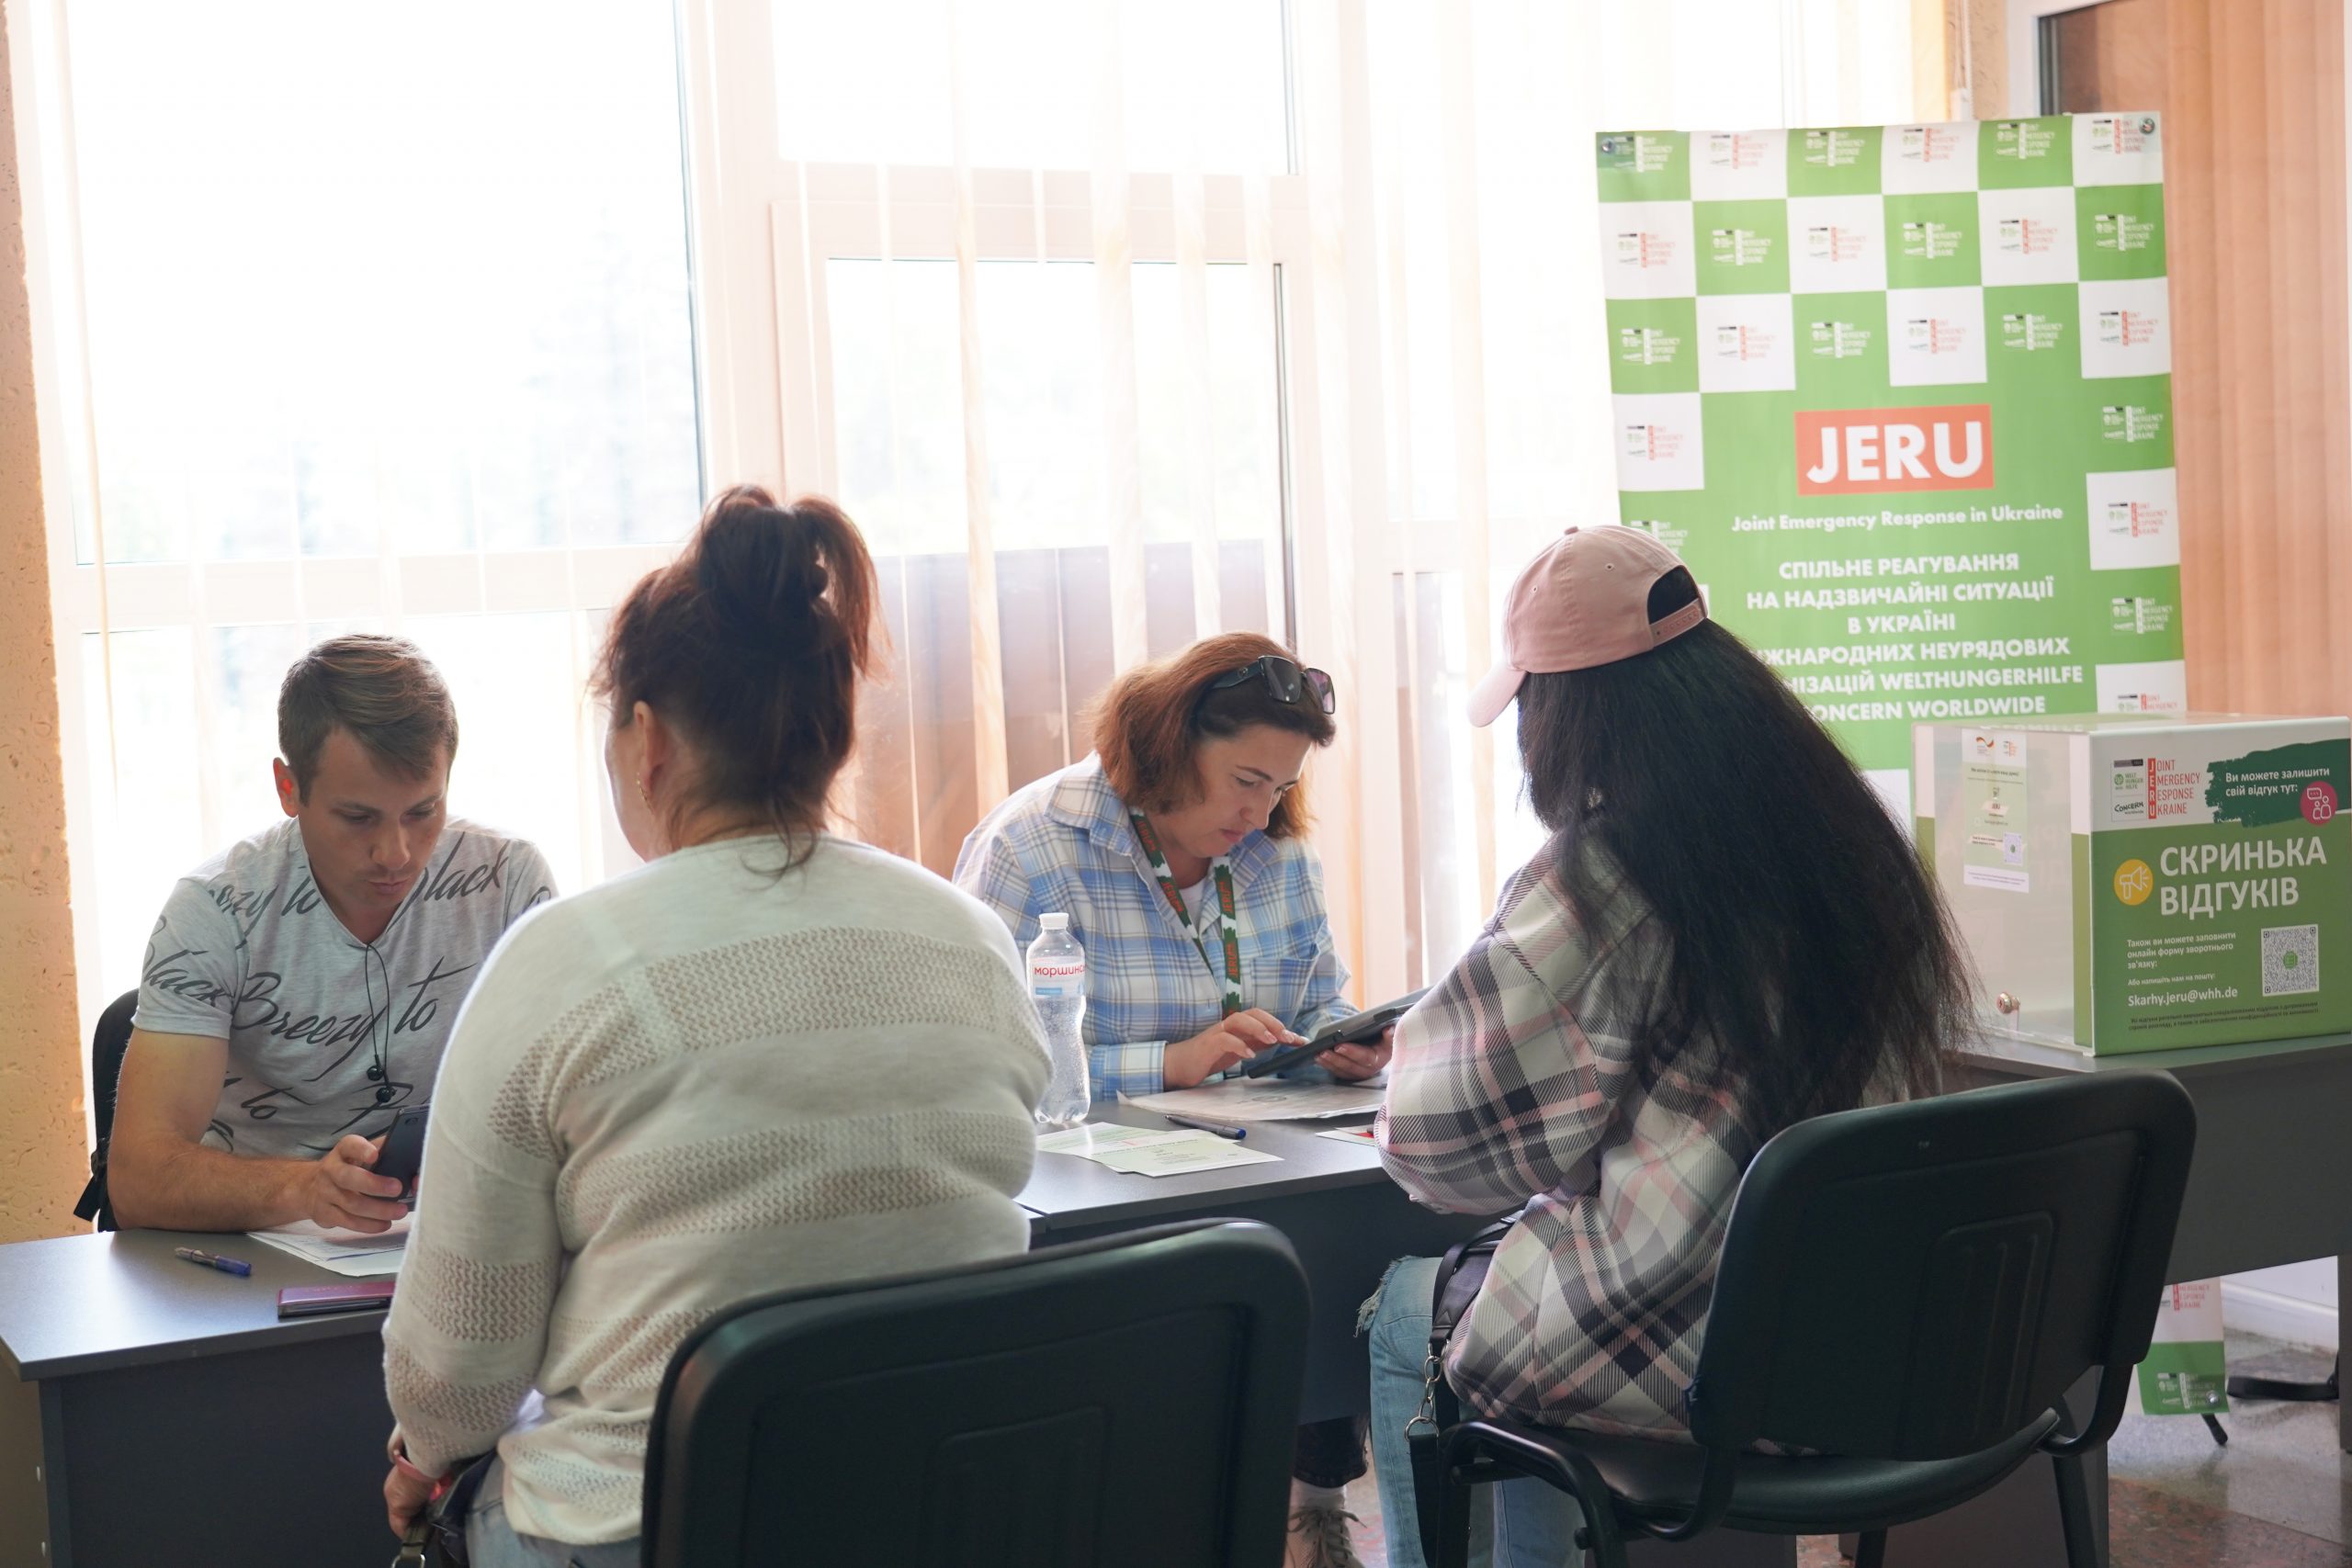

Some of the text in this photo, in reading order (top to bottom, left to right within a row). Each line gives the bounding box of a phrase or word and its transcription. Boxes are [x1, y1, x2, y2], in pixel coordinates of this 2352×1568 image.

[1806, 421, 1983, 484] JERU
[1732, 503, 2064, 533] Joint Emergency Response in Ukraine
[1779, 553, 2019, 580] СПІЛЬНЕ РЕАГУВАННЯ
[1747, 575, 2054, 610] НА НАДЗВИЧАЙНІ СИТУАЦІЇ
[1848, 609, 1955, 634] В УКРАЇНІ
[1920, 637, 2071, 660] НЕУРЯДОВИХ
[1880, 665, 2083, 690] WELTHUNGERHILFE
[1808, 695, 2046, 722] ONCERN WORLDWIDE
[2225, 768, 2330, 783] Ви можете залишити
[2225, 784, 2298, 797] свій відгук тут:
[2160, 836, 2327, 876] СКРИНЬКА
[2160, 877, 2300, 920] ВІДГУКІВ
[2127, 939, 2152, 948] Також
[2164, 935, 2194, 944] можете
[2195, 932, 2236, 942] заповнити
[2127, 942, 2234, 958] онлайн форму зворотнього
[2141, 976, 2171, 985] напишіть
[2194, 973, 2216, 981] пошту:
[2128, 986, 2238, 1007] Skarhy.jeru@whh.de
[232, 972, 390, 1082] Breezy
[394, 955, 479, 1033] to
